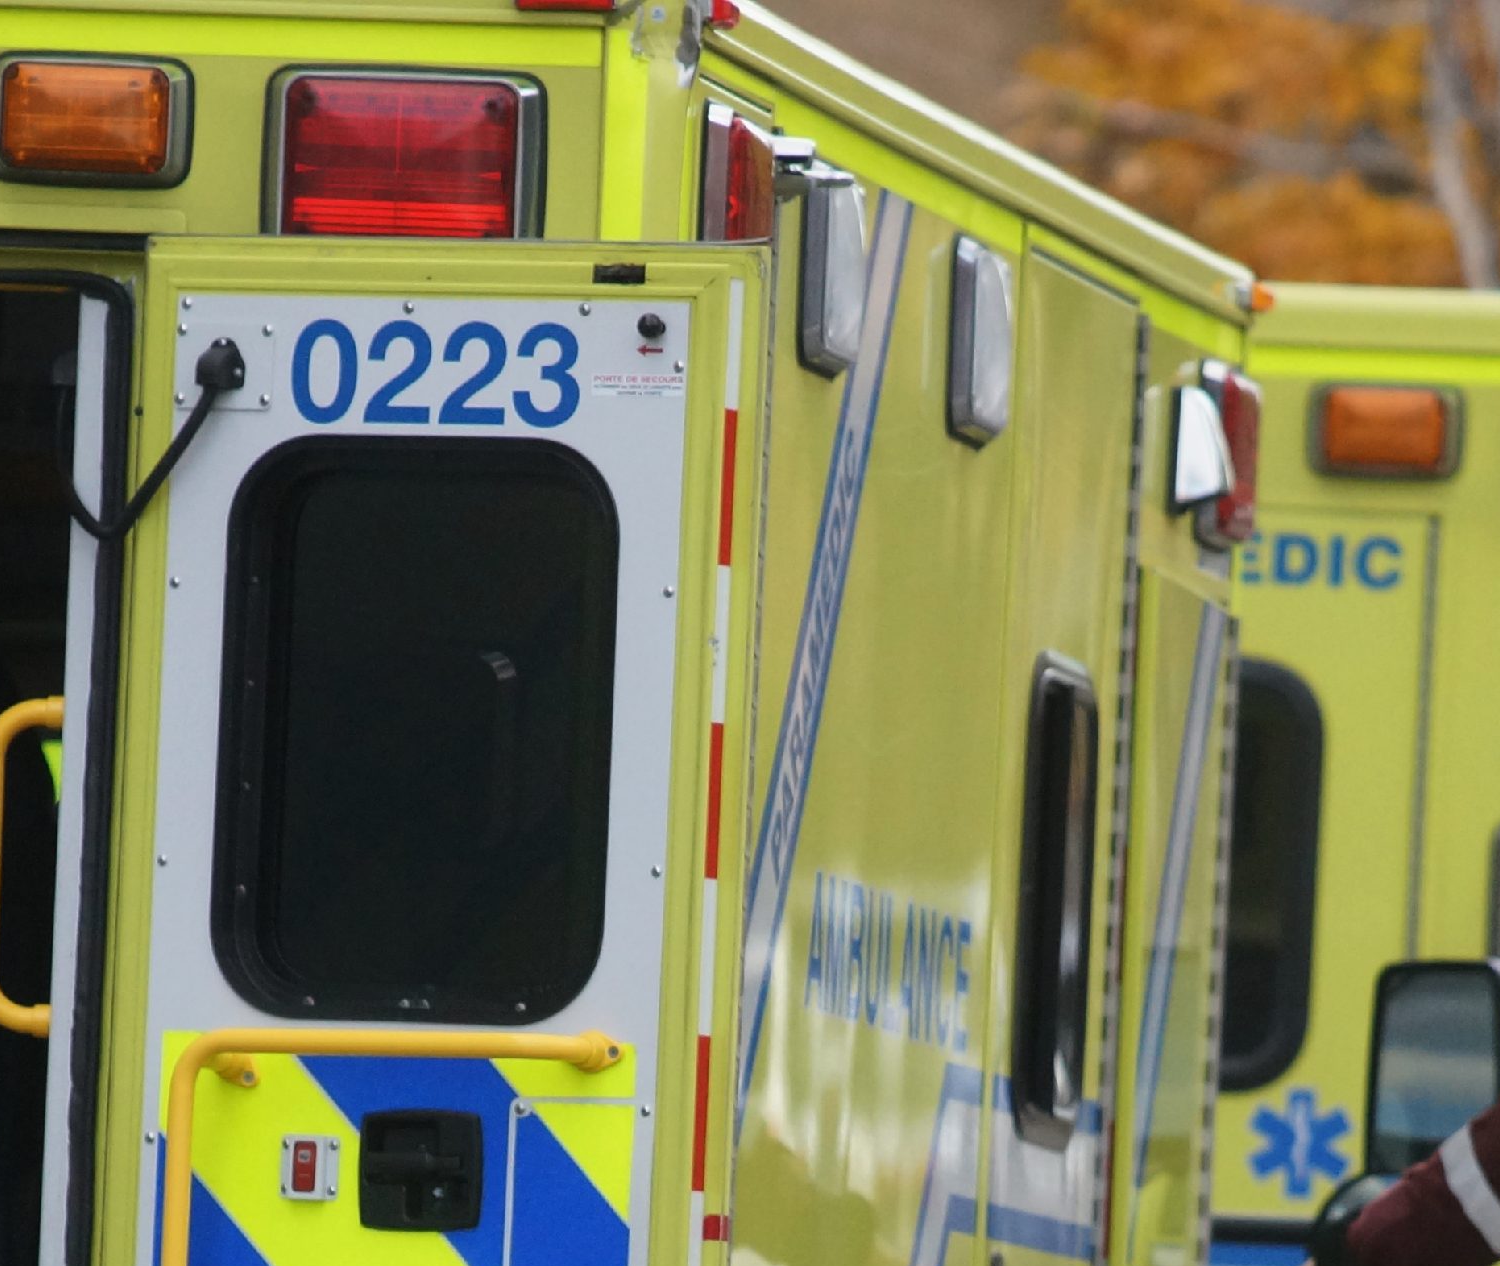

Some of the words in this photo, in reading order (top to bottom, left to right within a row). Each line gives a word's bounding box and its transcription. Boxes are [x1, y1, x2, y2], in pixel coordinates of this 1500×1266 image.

[291, 318, 580, 428] 0223
[772, 429, 856, 883] PARAMEDIC
[804, 870, 971, 1055] AMBULANCE
